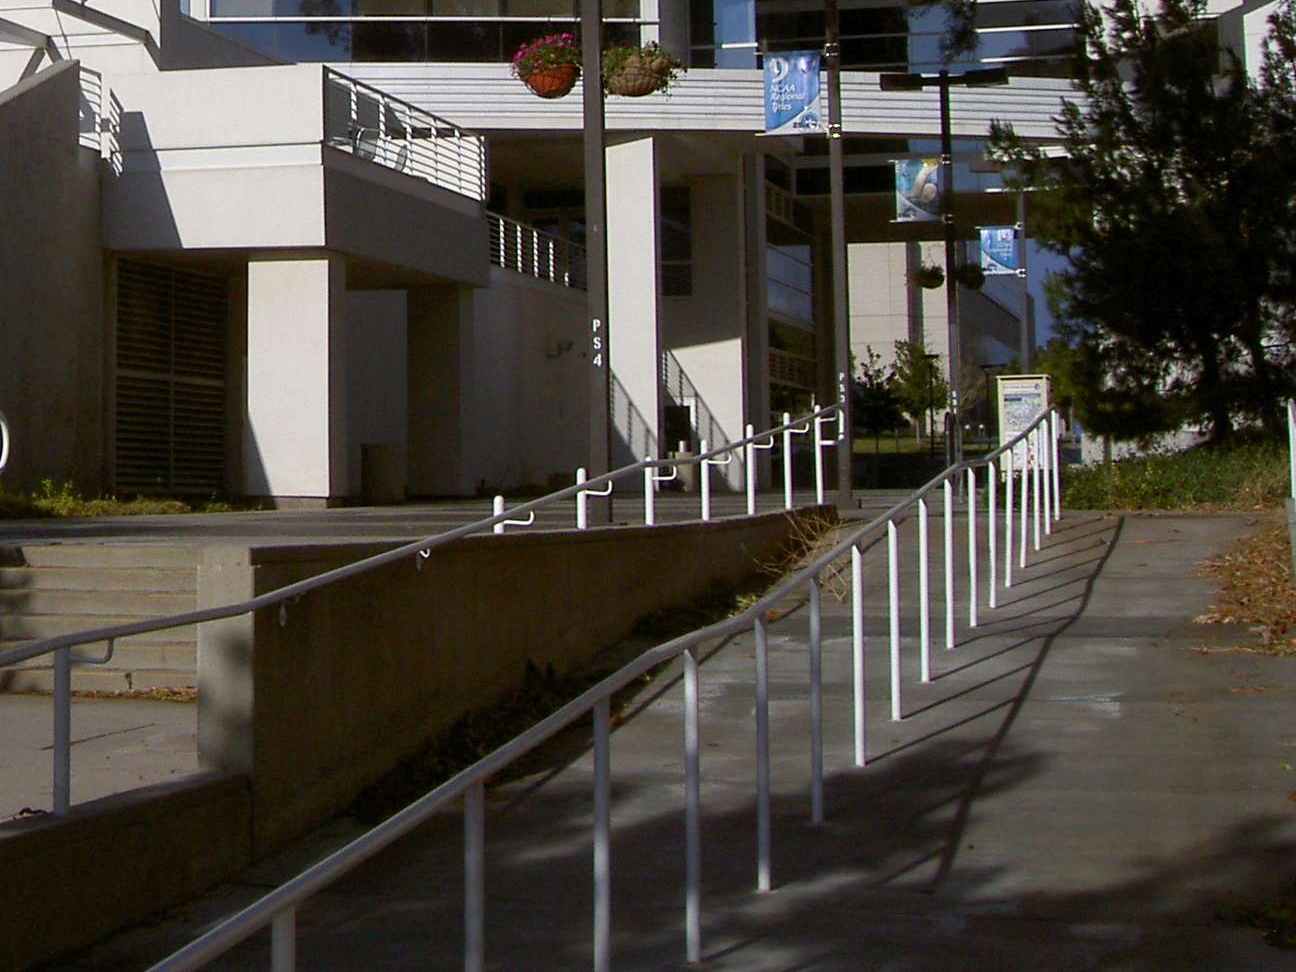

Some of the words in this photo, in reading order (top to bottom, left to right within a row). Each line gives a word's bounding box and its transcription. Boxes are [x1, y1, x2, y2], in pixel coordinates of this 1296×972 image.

[770, 58, 789, 82] 9
[770, 84, 796, 93] NCAA
[770, 92, 806, 102] Regional
[592, 318, 602, 366] PS4
